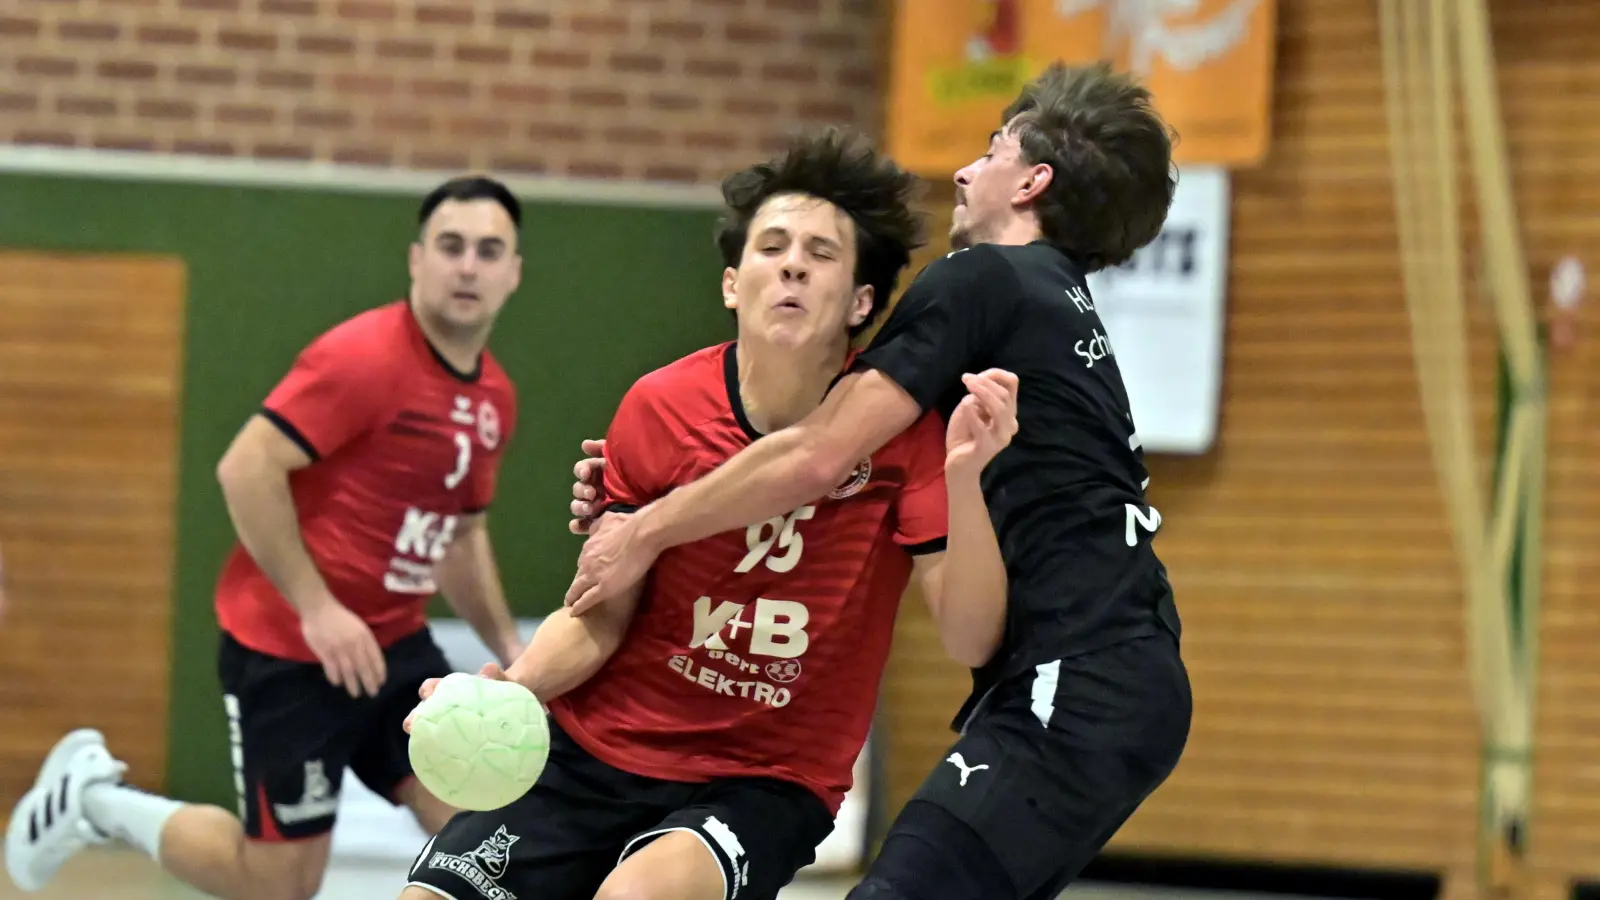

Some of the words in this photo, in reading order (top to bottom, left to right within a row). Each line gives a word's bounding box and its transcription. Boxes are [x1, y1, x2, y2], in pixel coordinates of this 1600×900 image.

[734, 505, 815, 573] 95
[689, 595, 810, 659] K+B
[667, 655, 791, 708] ELEKTRO
